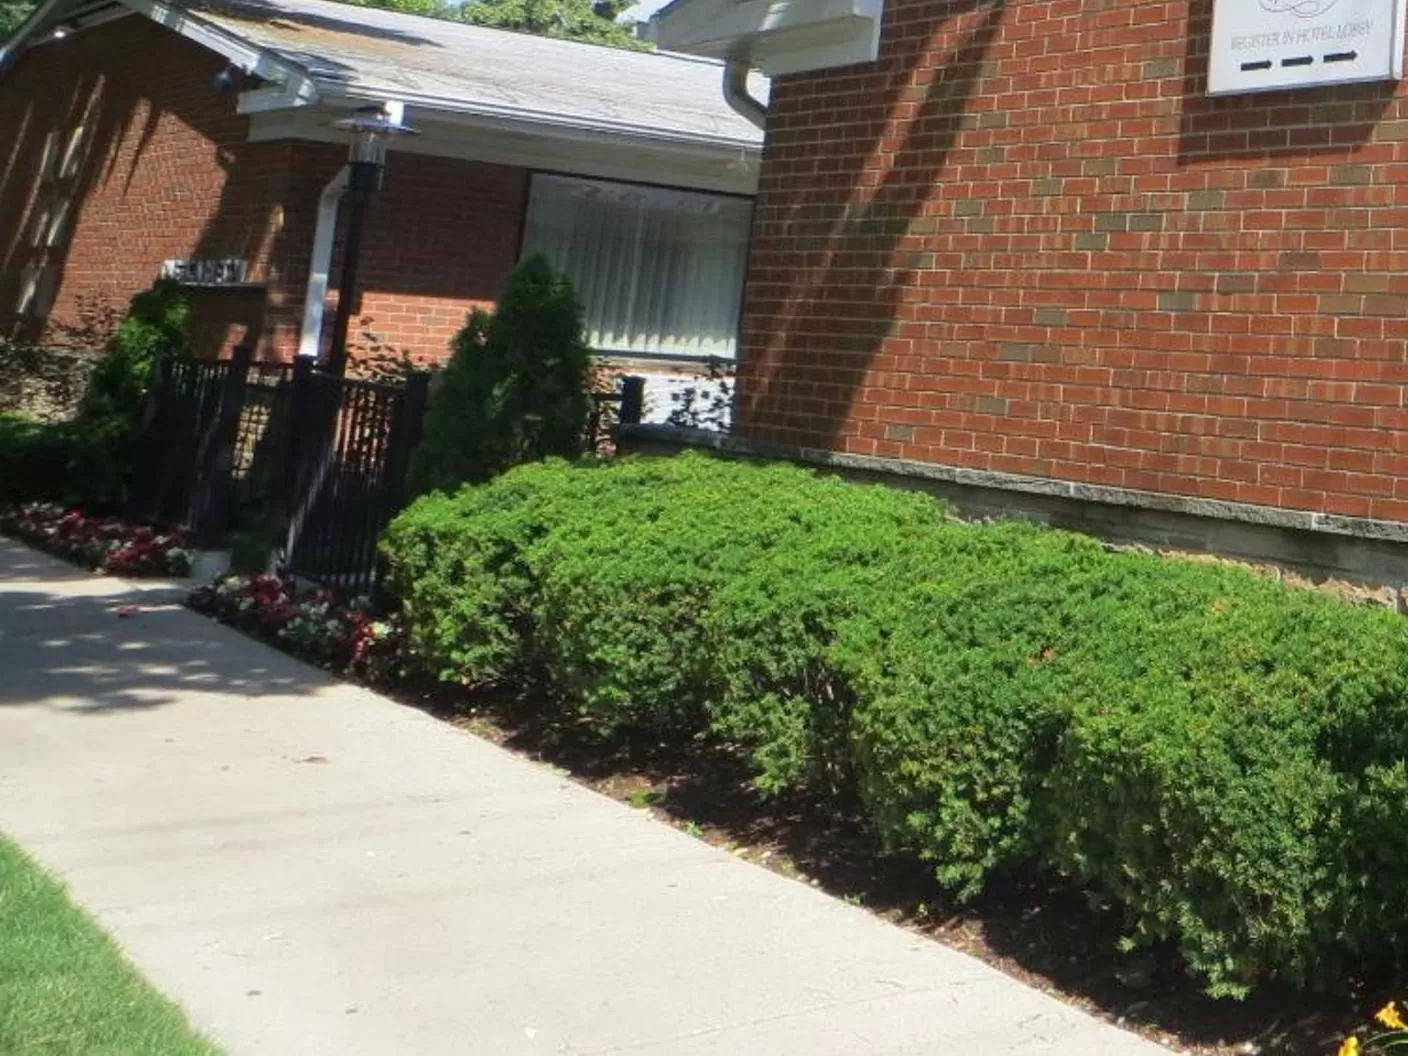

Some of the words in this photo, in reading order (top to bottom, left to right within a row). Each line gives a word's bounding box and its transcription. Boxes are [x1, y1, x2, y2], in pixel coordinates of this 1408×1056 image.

[1231, 30, 1279, 51] REGISTER
[1281, 27, 1293, 45] IN
[1295, 23, 1335, 45] HOTEL
[1336, 18, 1374, 40] LOBBY
